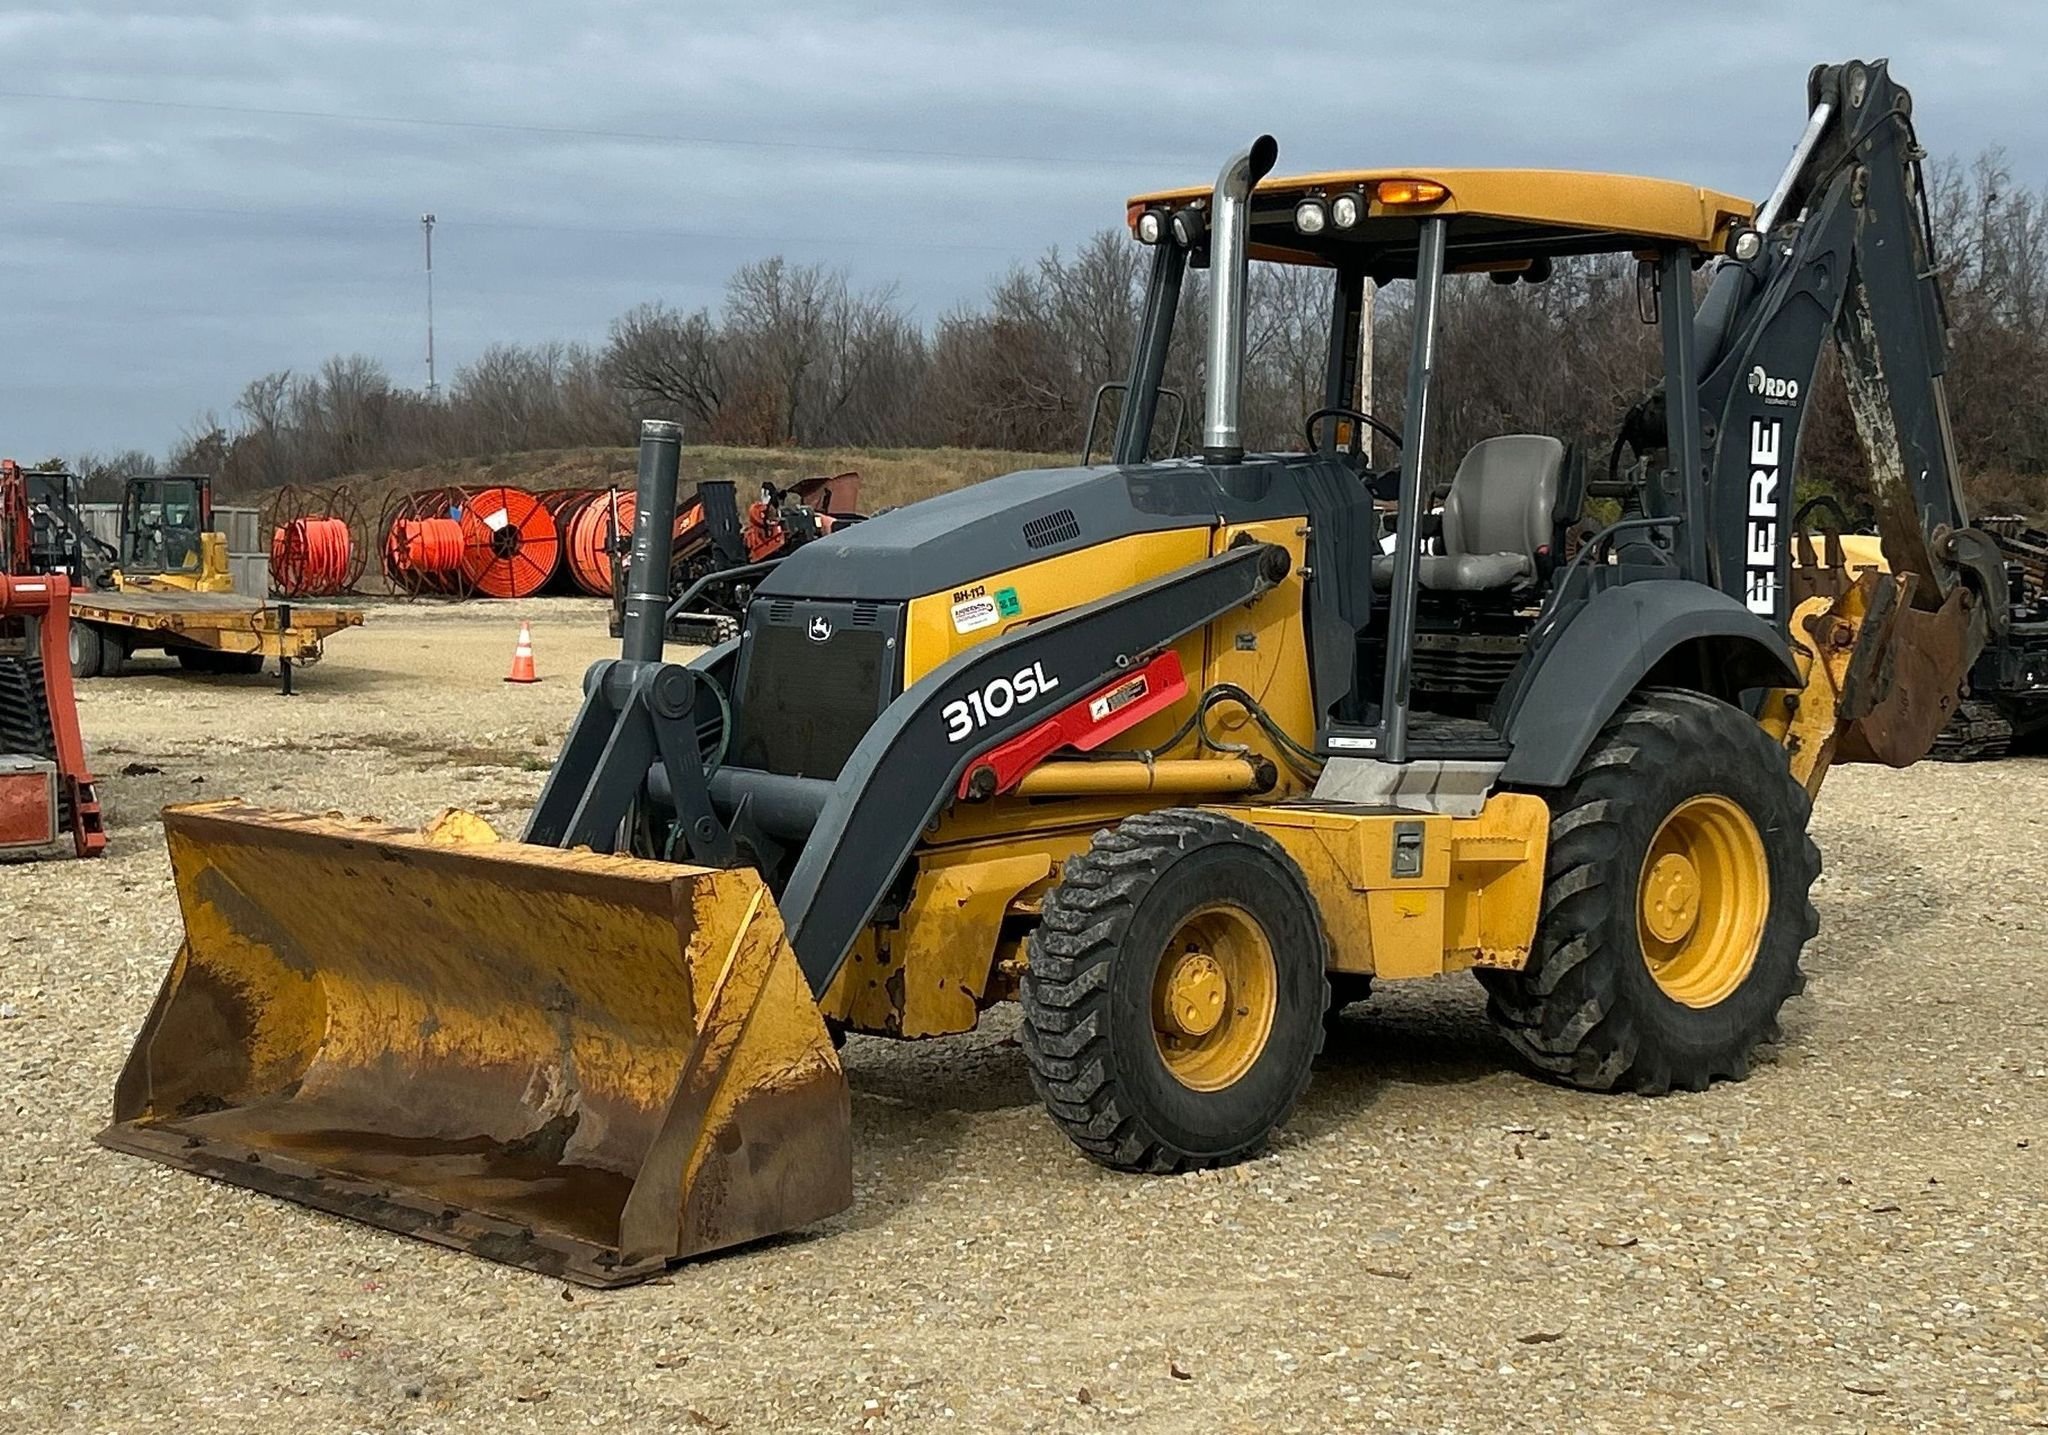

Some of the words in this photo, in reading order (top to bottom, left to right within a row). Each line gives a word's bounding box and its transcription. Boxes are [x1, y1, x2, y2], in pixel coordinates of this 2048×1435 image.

[1766, 377, 1798, 399] RDO
[953, 585, 986, 603] BH-113
[941, 660, 1060, 742] 310SL
